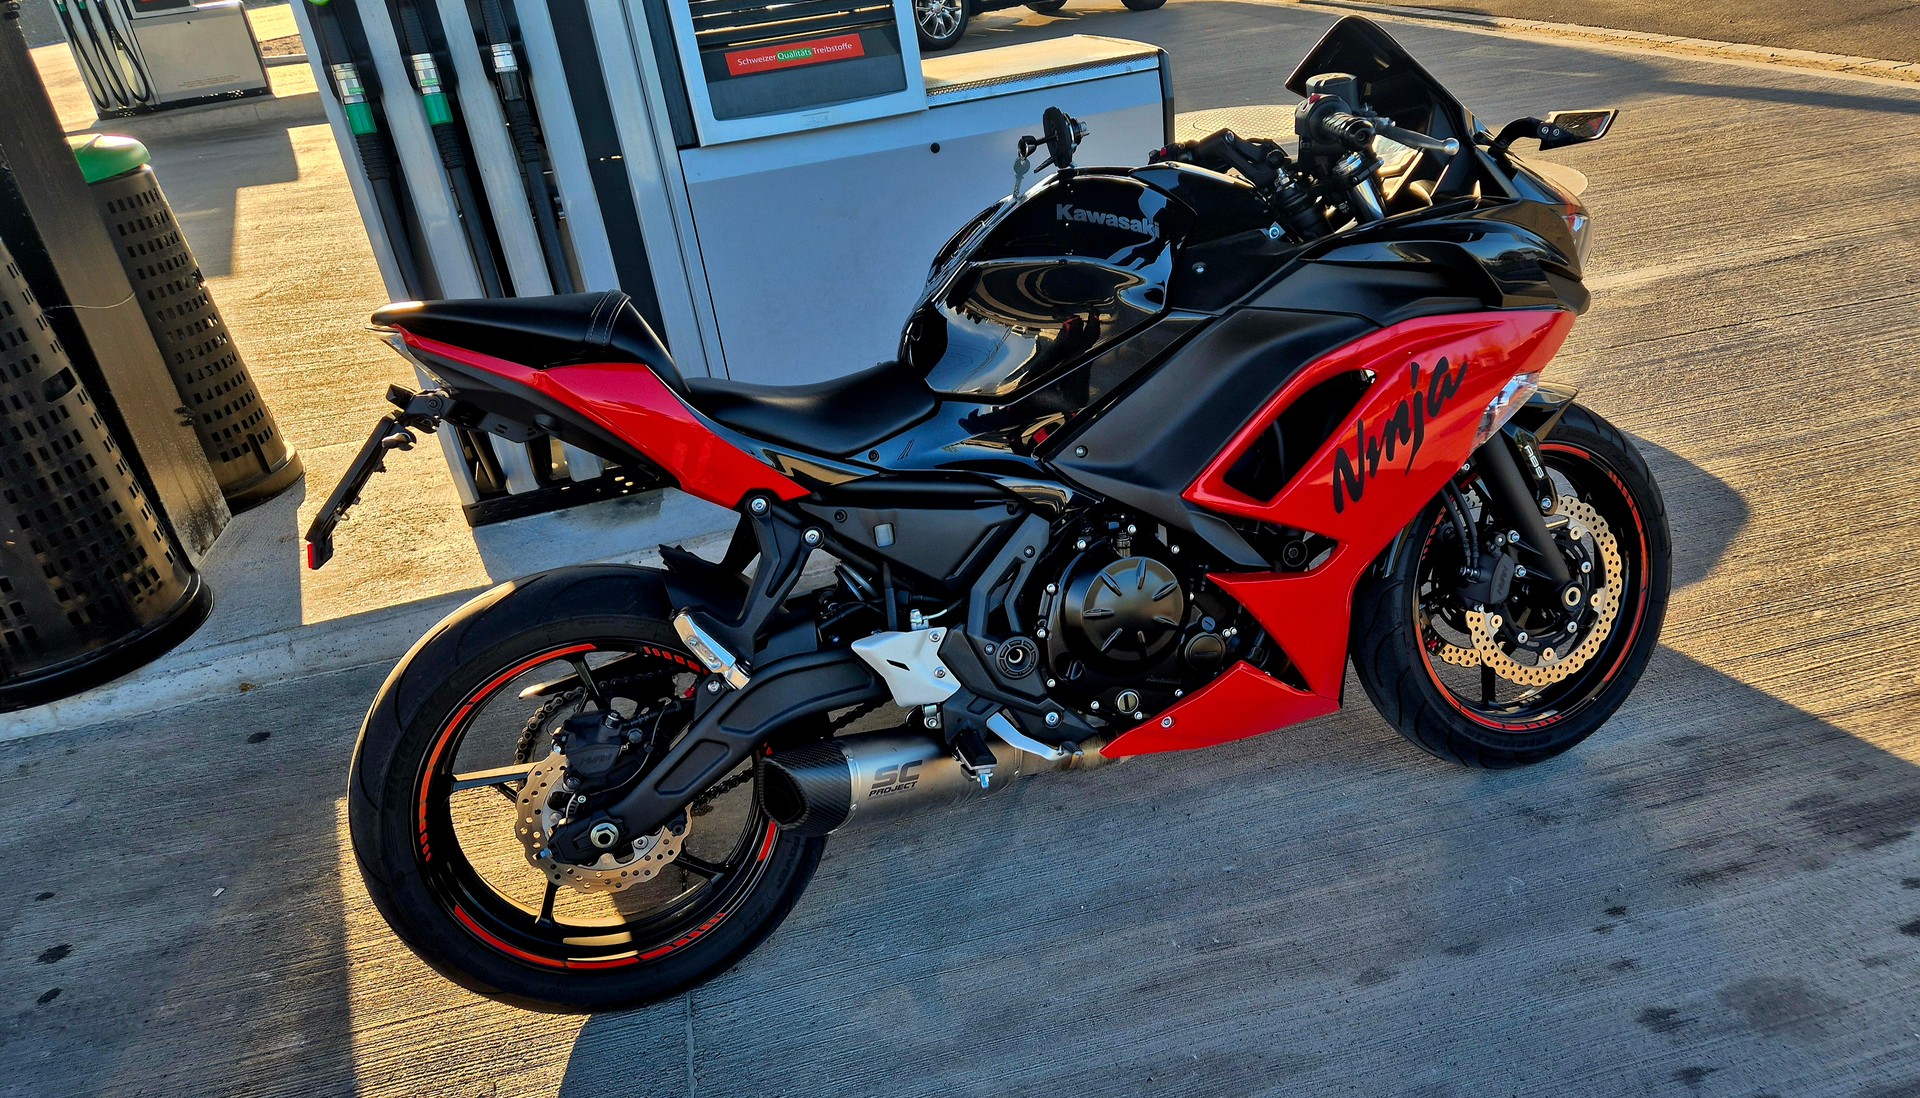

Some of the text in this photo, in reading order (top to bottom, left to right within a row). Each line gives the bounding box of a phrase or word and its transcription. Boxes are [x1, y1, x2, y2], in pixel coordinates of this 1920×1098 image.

[737, 42, 853, 66] Schweizer Qualitäts Treibstoffe
[1056, 203, 1160, 238] Kawasaki
[1332, 356, 1468, 515] Ninja
[1524, 444, 1545, 479] ABS
[868, 781, 918, 797] PROJECT
[871, 759, 923, 789] SC
